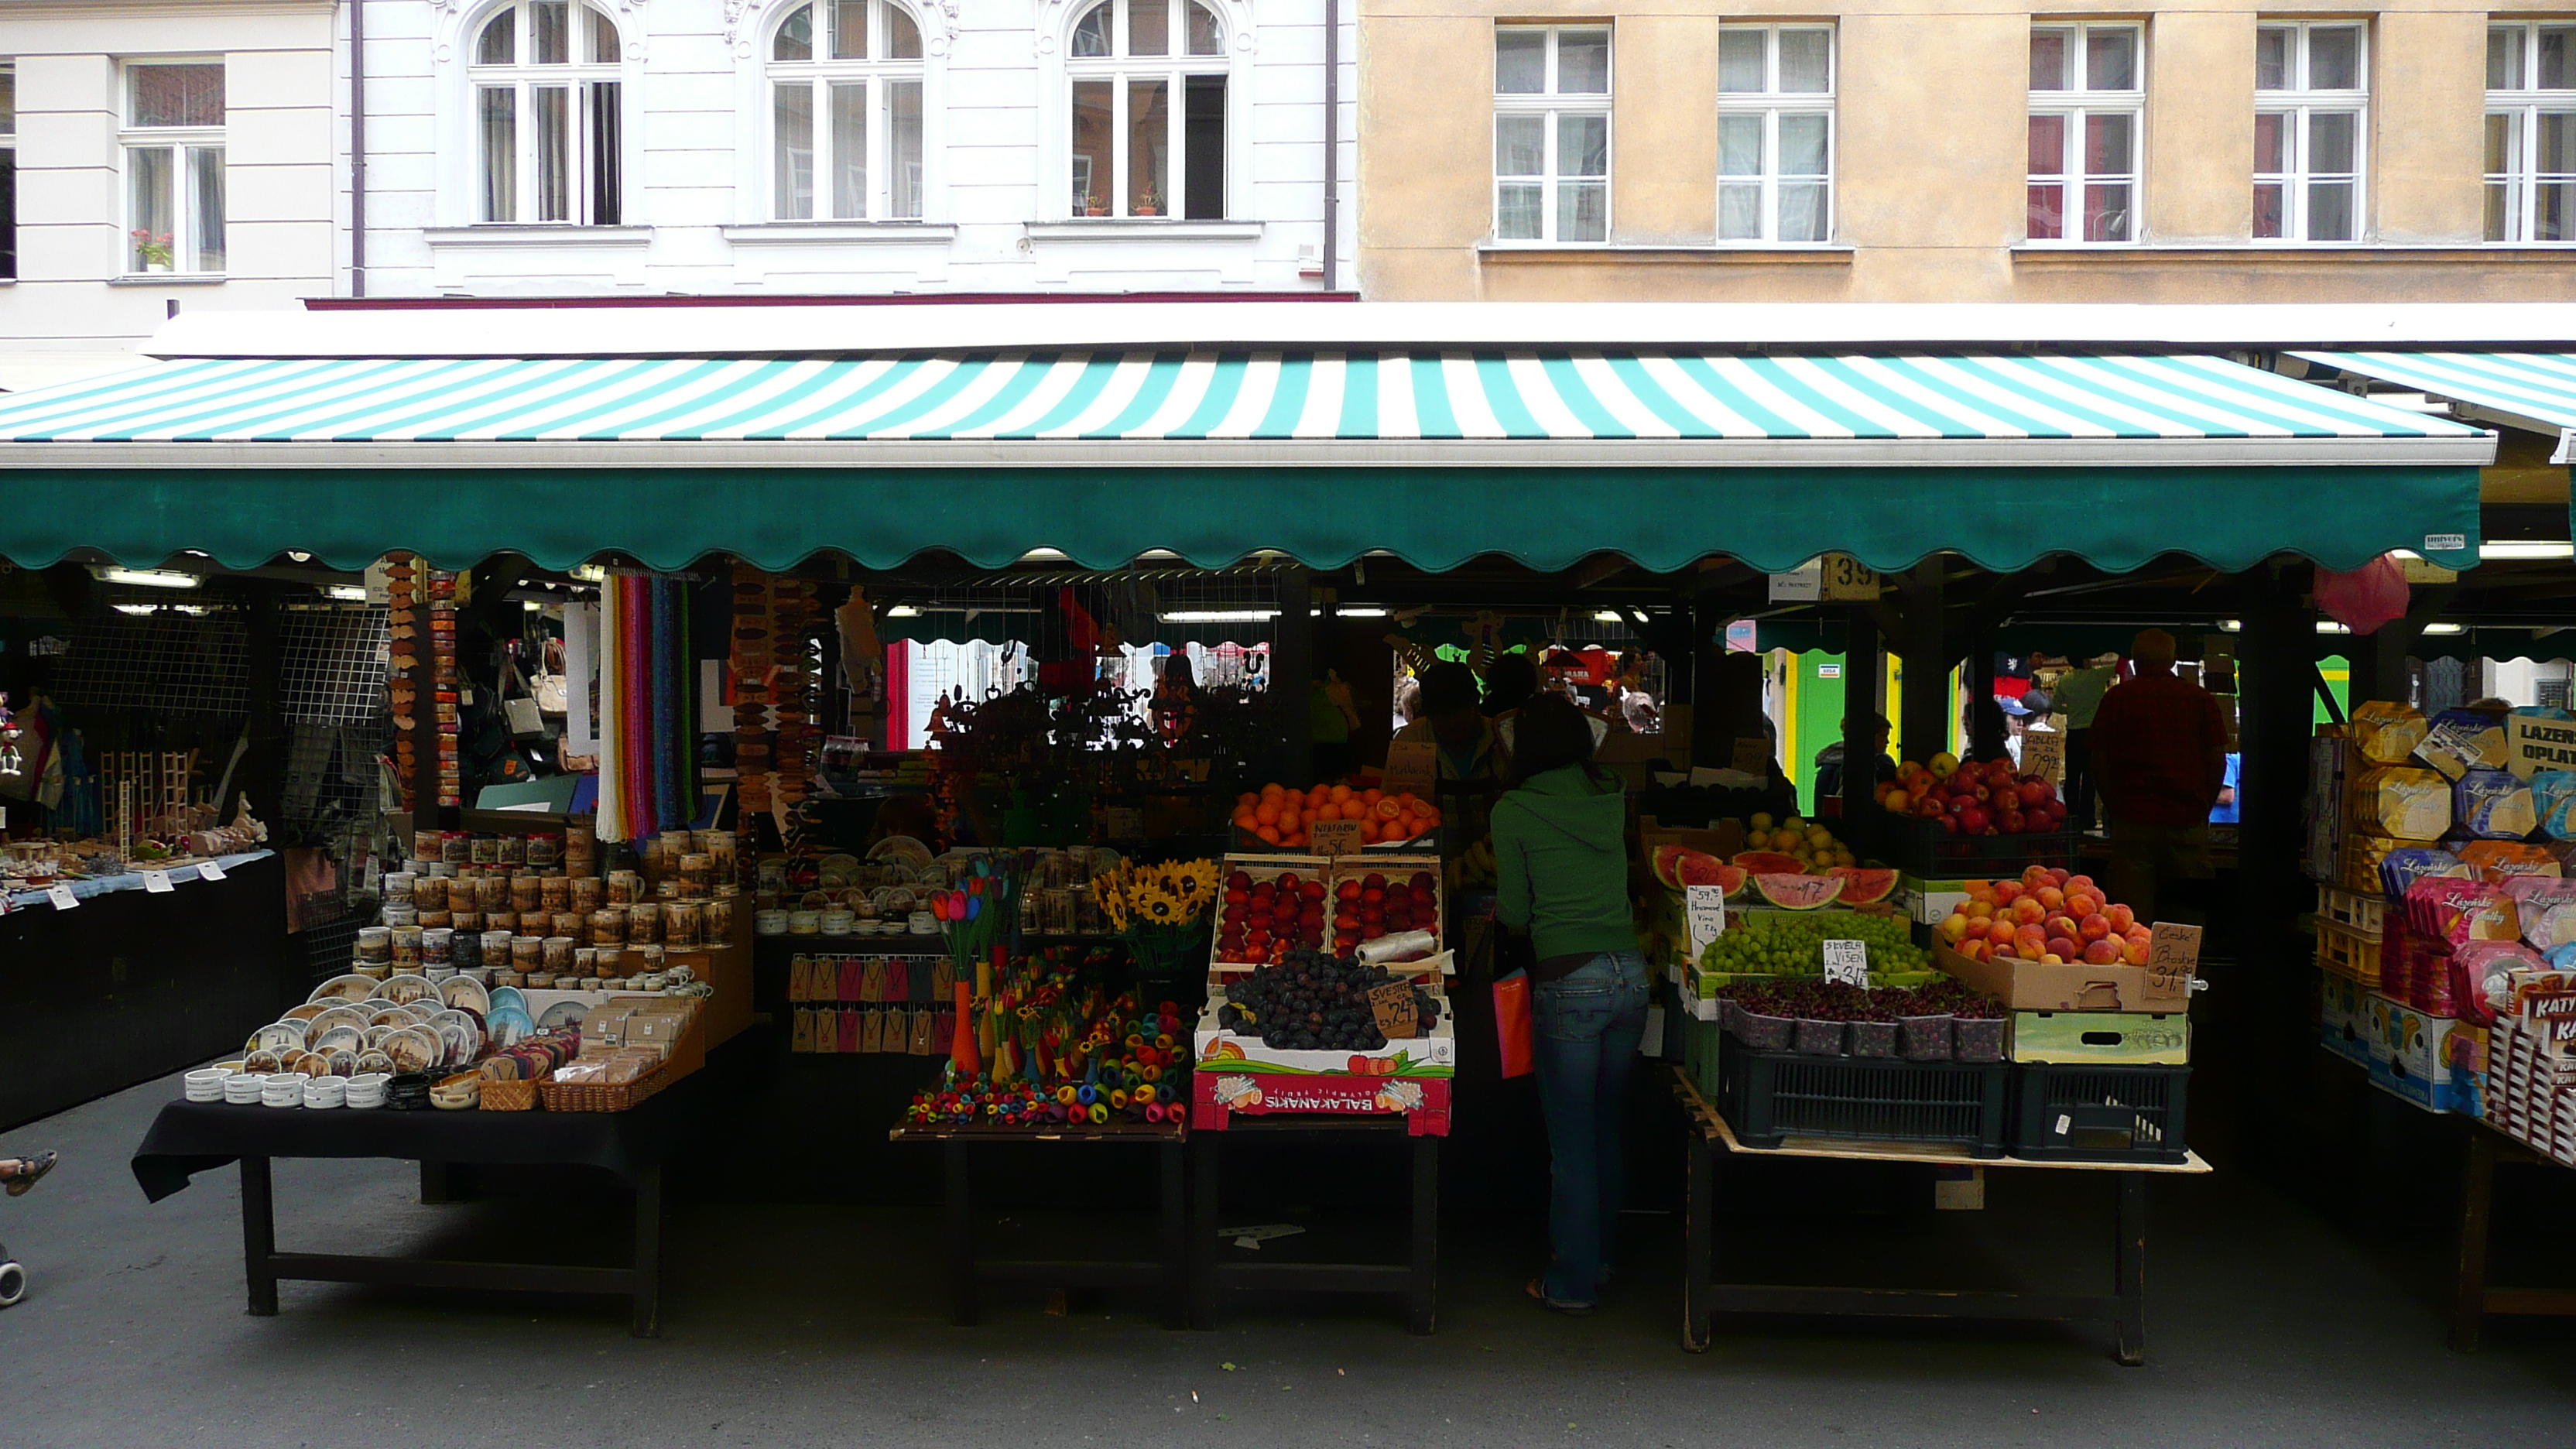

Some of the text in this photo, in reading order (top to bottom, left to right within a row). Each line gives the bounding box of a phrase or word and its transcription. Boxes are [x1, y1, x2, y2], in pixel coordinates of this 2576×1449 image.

[1838, 557, 1872, 586] 39
[2441, 892, 2494, 912] Lázeňské
[1264, 1095, 1373, 1112] BALAKANAKIS
